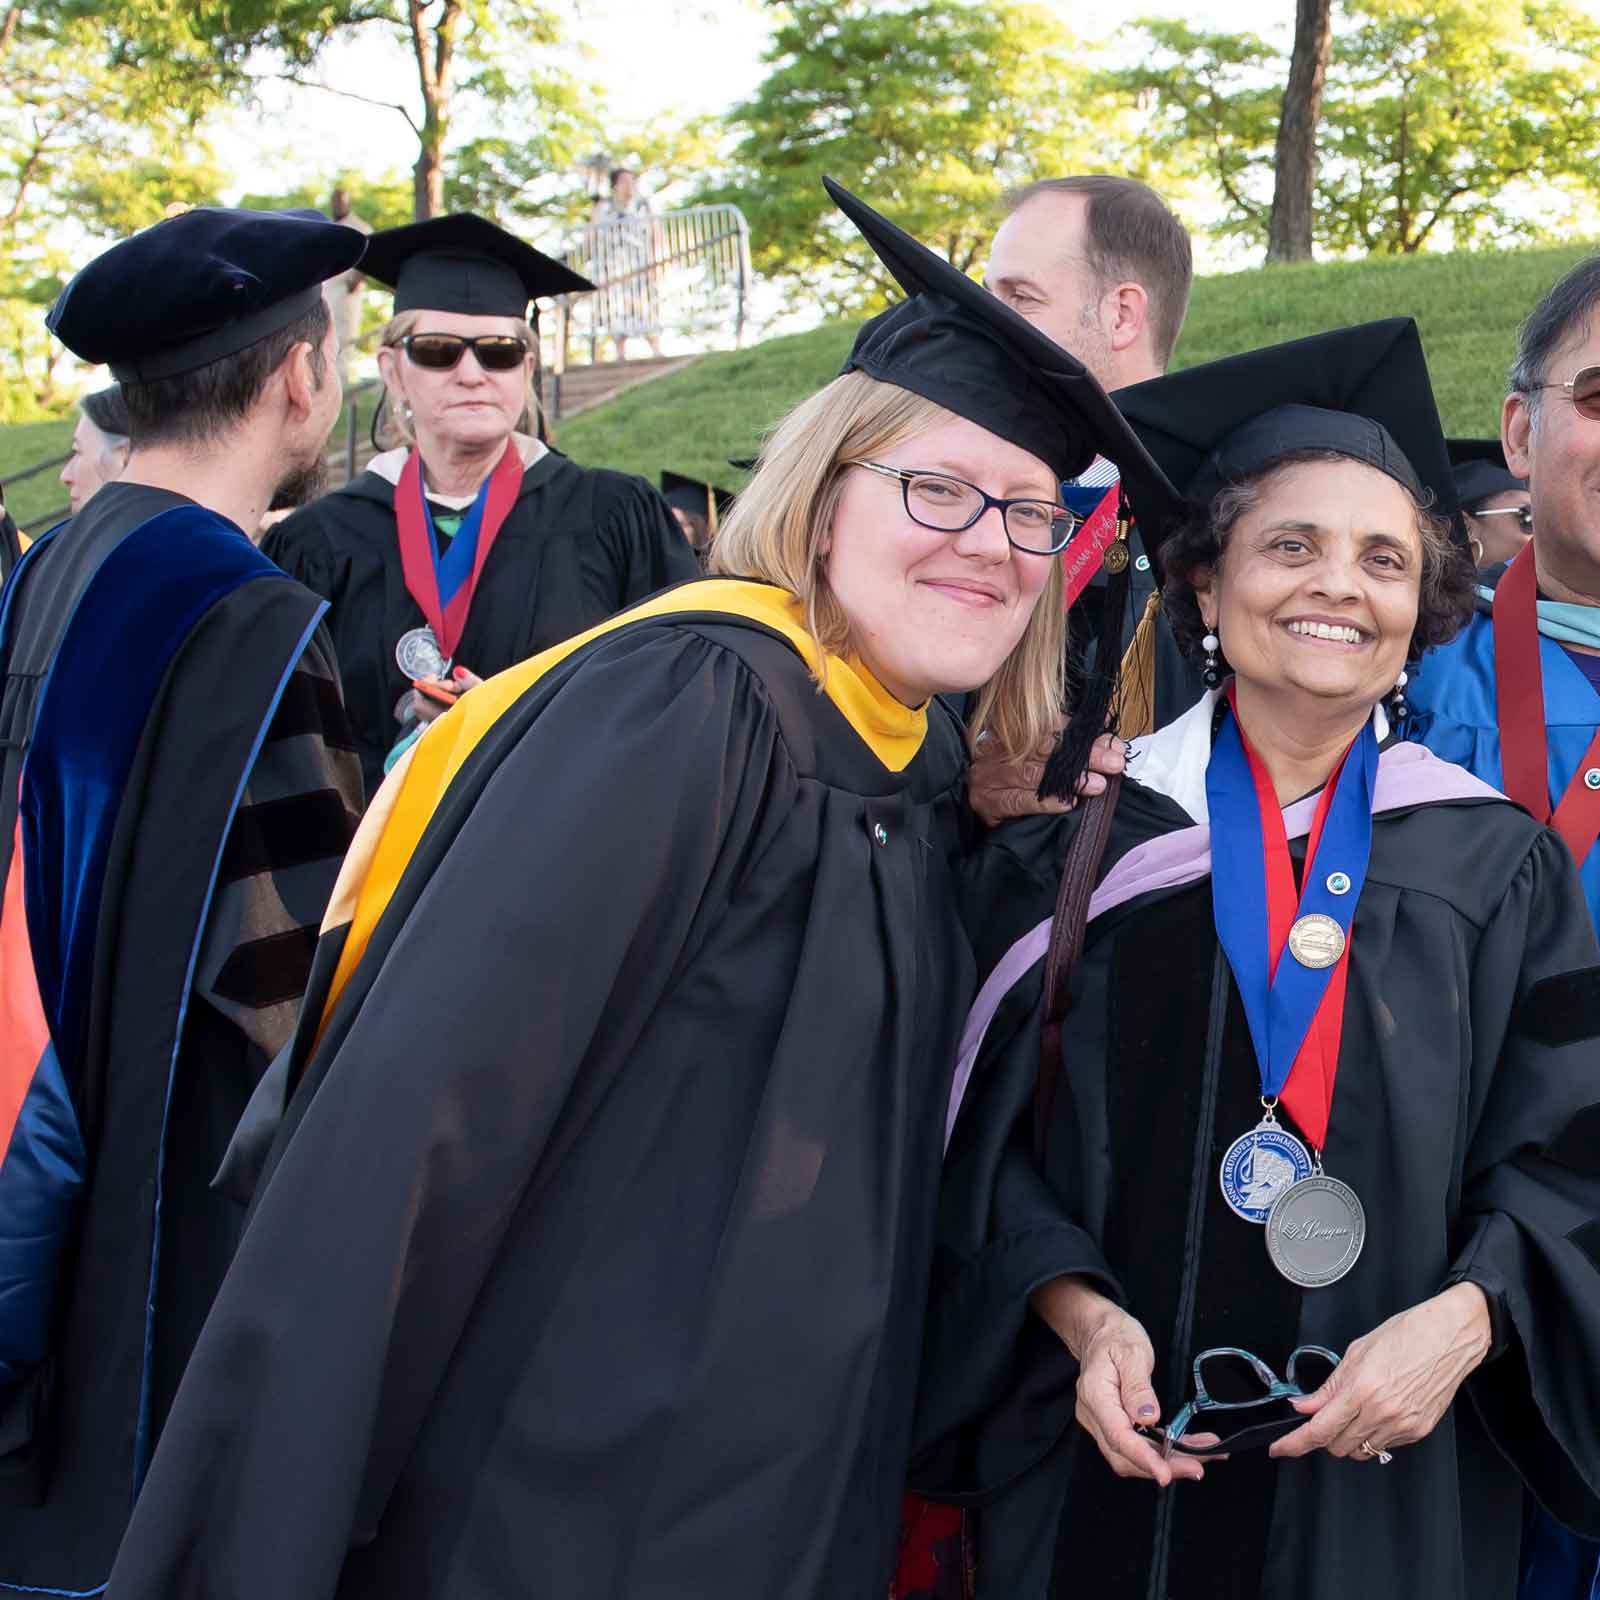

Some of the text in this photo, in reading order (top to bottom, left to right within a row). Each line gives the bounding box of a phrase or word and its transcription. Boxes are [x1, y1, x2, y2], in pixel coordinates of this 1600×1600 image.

[1224, 1132, 1308, 1208] ANNE ARUNDEL COMMUNITY
[1255, 1210, 1268, 1219] 19
